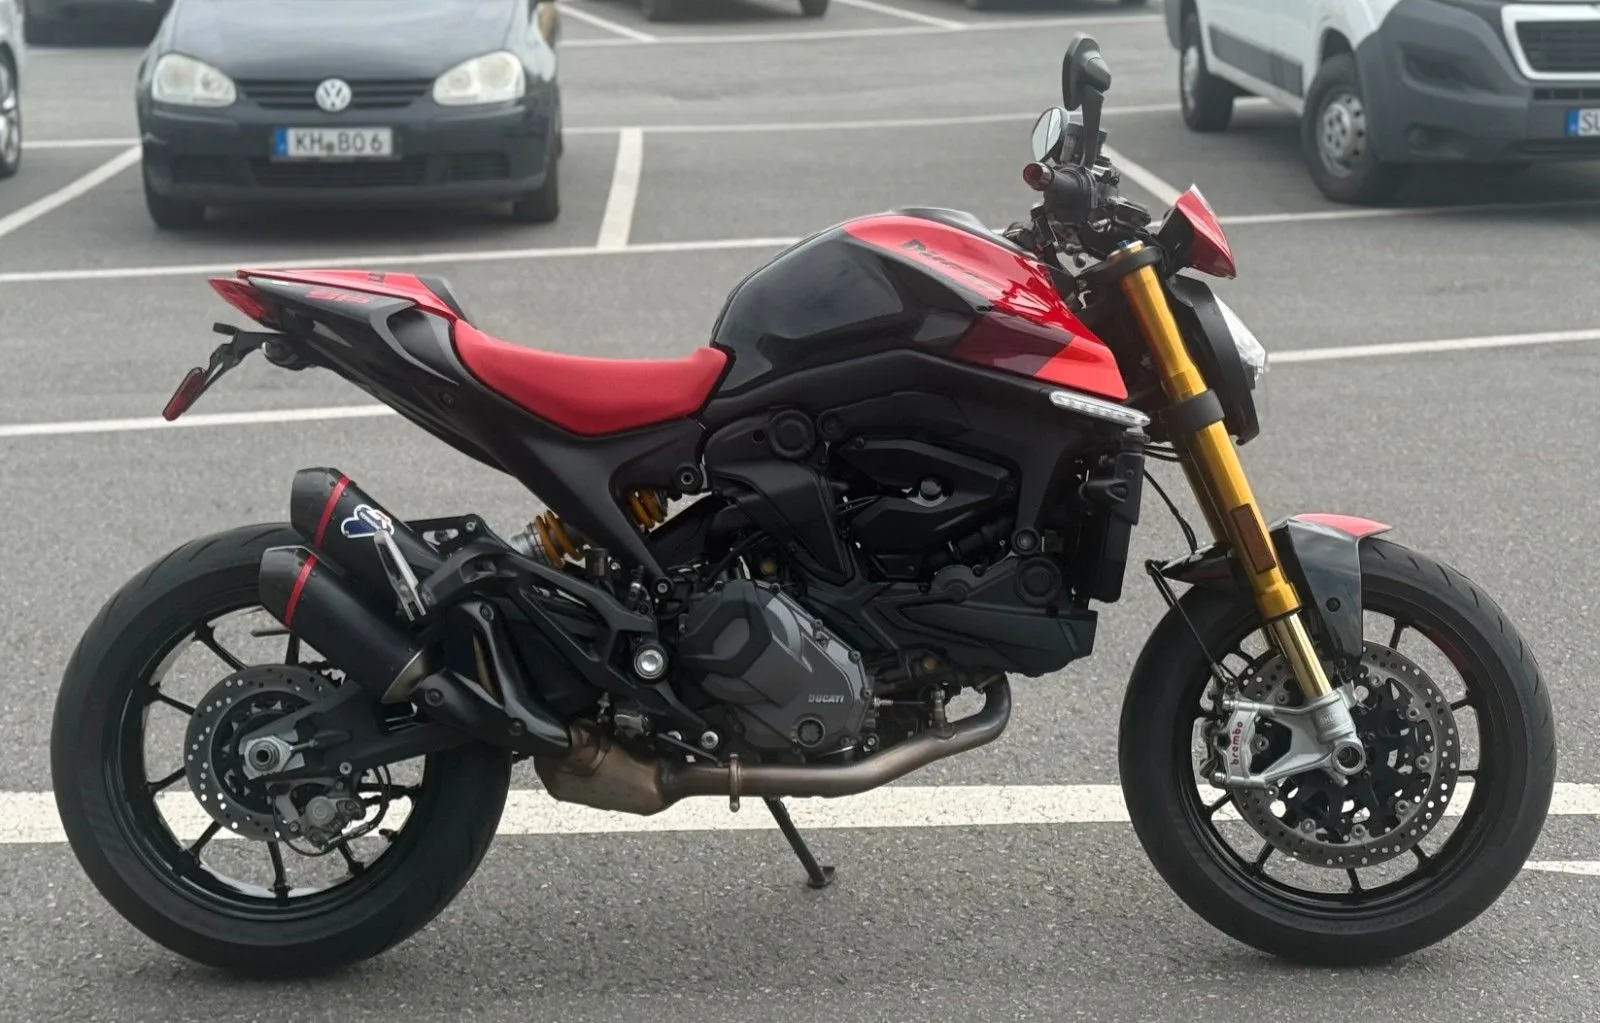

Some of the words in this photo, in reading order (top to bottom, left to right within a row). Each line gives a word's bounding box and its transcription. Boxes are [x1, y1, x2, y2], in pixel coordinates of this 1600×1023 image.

[295, 132, 323, 151] KH
[370, 132, 383, 152] 6
[807, 694, 845, 703] DUCATI
[1230, 721, 1244, 766] brembo
